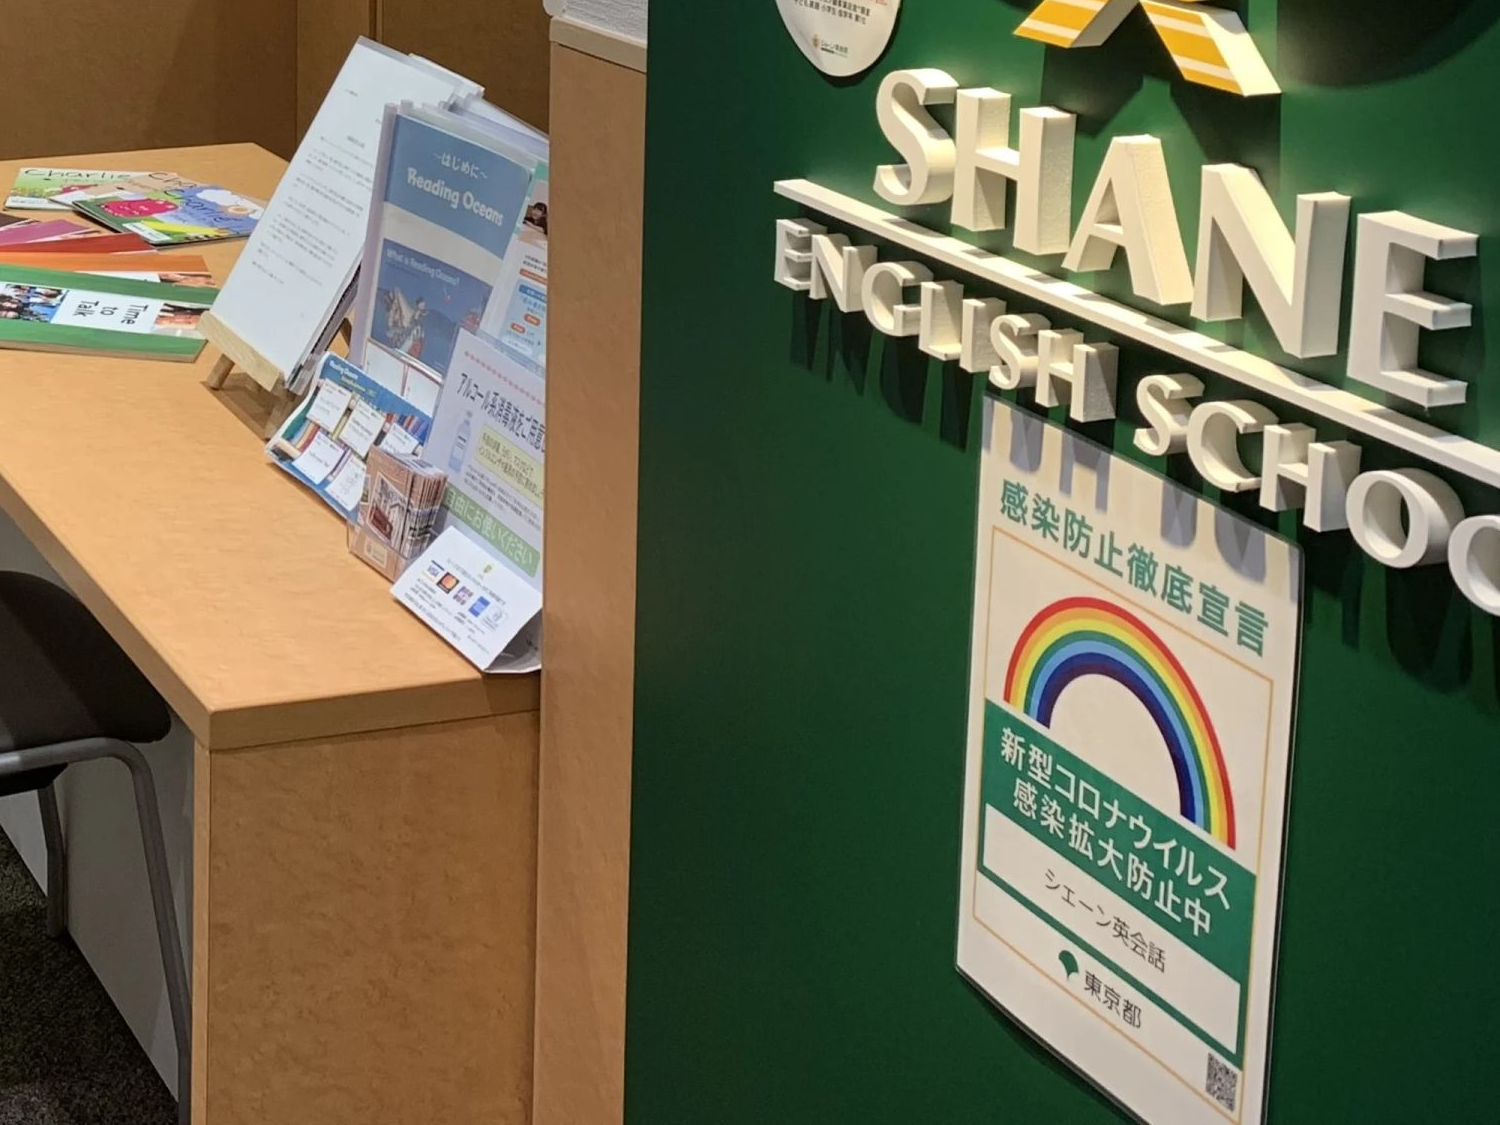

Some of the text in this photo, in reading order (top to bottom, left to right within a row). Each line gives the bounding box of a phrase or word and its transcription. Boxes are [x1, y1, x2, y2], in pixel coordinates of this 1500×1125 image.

[23, 166, 132, 181] Charlie
[406, 167, 504, 227] Reading Oceans
[873, 68, 1478, 407] SHANE
[73, 300, 100, 318] Talk
[101, 304, 118, 316] to
[120, 303, 150, 325] Time
[773, 218, 1119, 423] ENGLISH
[998, 478, 1270, 658] 感染防止徹底宣言
[1000, 725, 1232, 912] 新型コロナウイルス
[1012, 778, 1213, 938] 感染拡大防止中
[1044, 866, 1168, 974] シェーン英会話
[1083, 968, 1143, 1031] 東京都
